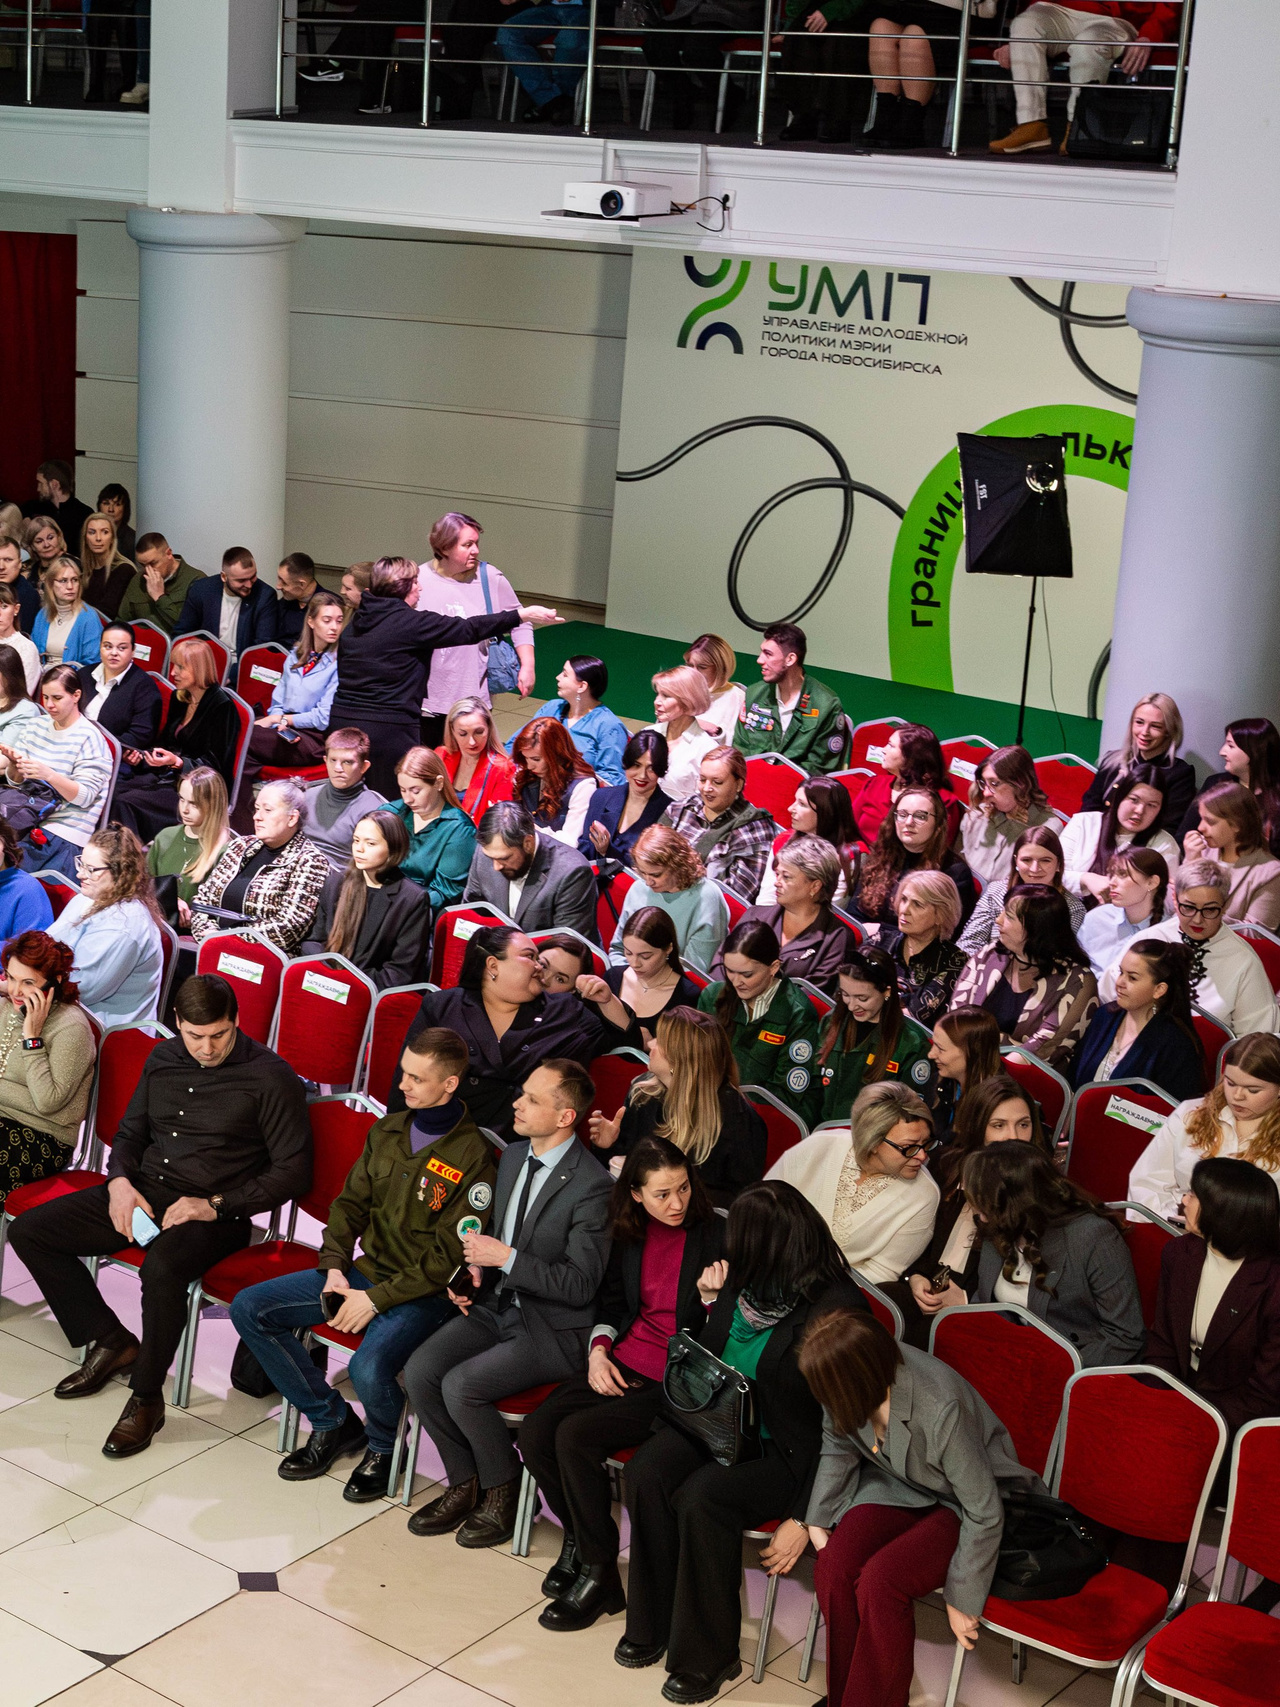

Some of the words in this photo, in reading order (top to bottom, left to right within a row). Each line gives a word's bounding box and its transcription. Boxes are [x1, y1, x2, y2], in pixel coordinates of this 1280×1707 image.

[768, 262, 931, 325] УМП
[761, 331, 836, 349] ПОЛИТИКИ
[839, 340, 892, 354] МЭРИИ
[762, 315, 855, 335] УПРАВЛЕНИЕ
[858, 325, 968, 346] МОЛОДЕЖНОЙ
[760, 346, 818, 362] ГОРОДА
[821, 353, 943, 375] НОВОСИБИРСКА
